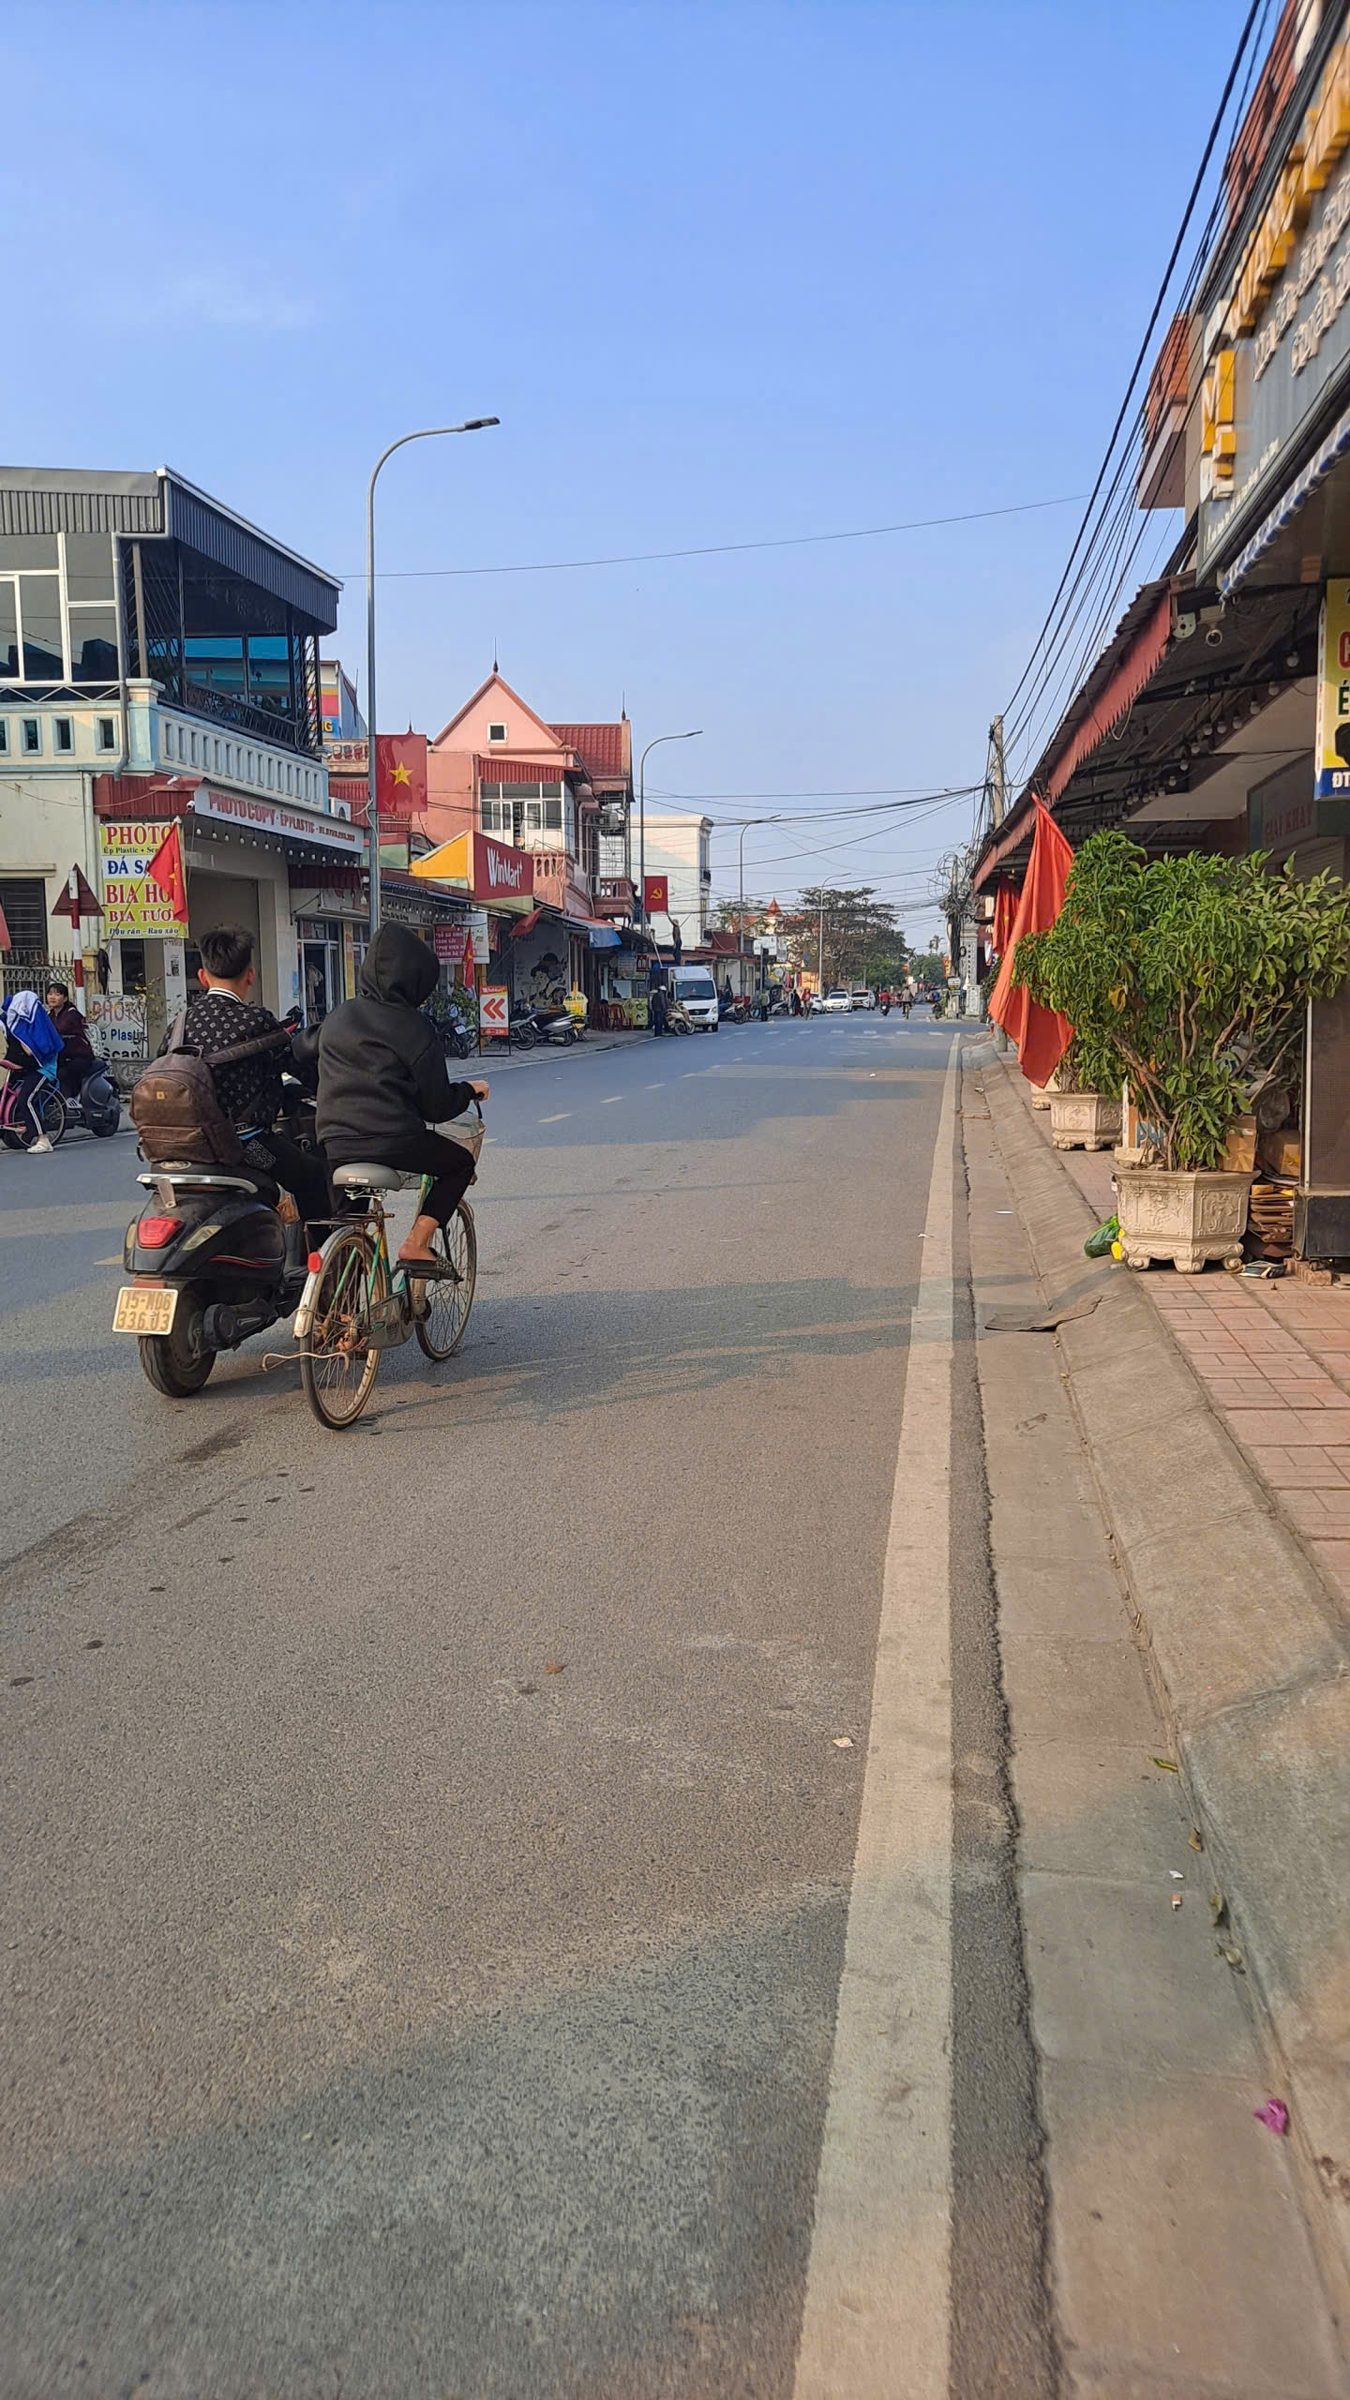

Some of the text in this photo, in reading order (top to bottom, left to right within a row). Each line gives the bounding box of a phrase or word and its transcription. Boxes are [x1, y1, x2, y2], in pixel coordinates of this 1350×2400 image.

[107, 855, 129, 875] ĐÁ
[106, 883, 138, 904] BIA
[109, 910, 135, 922] BIA
